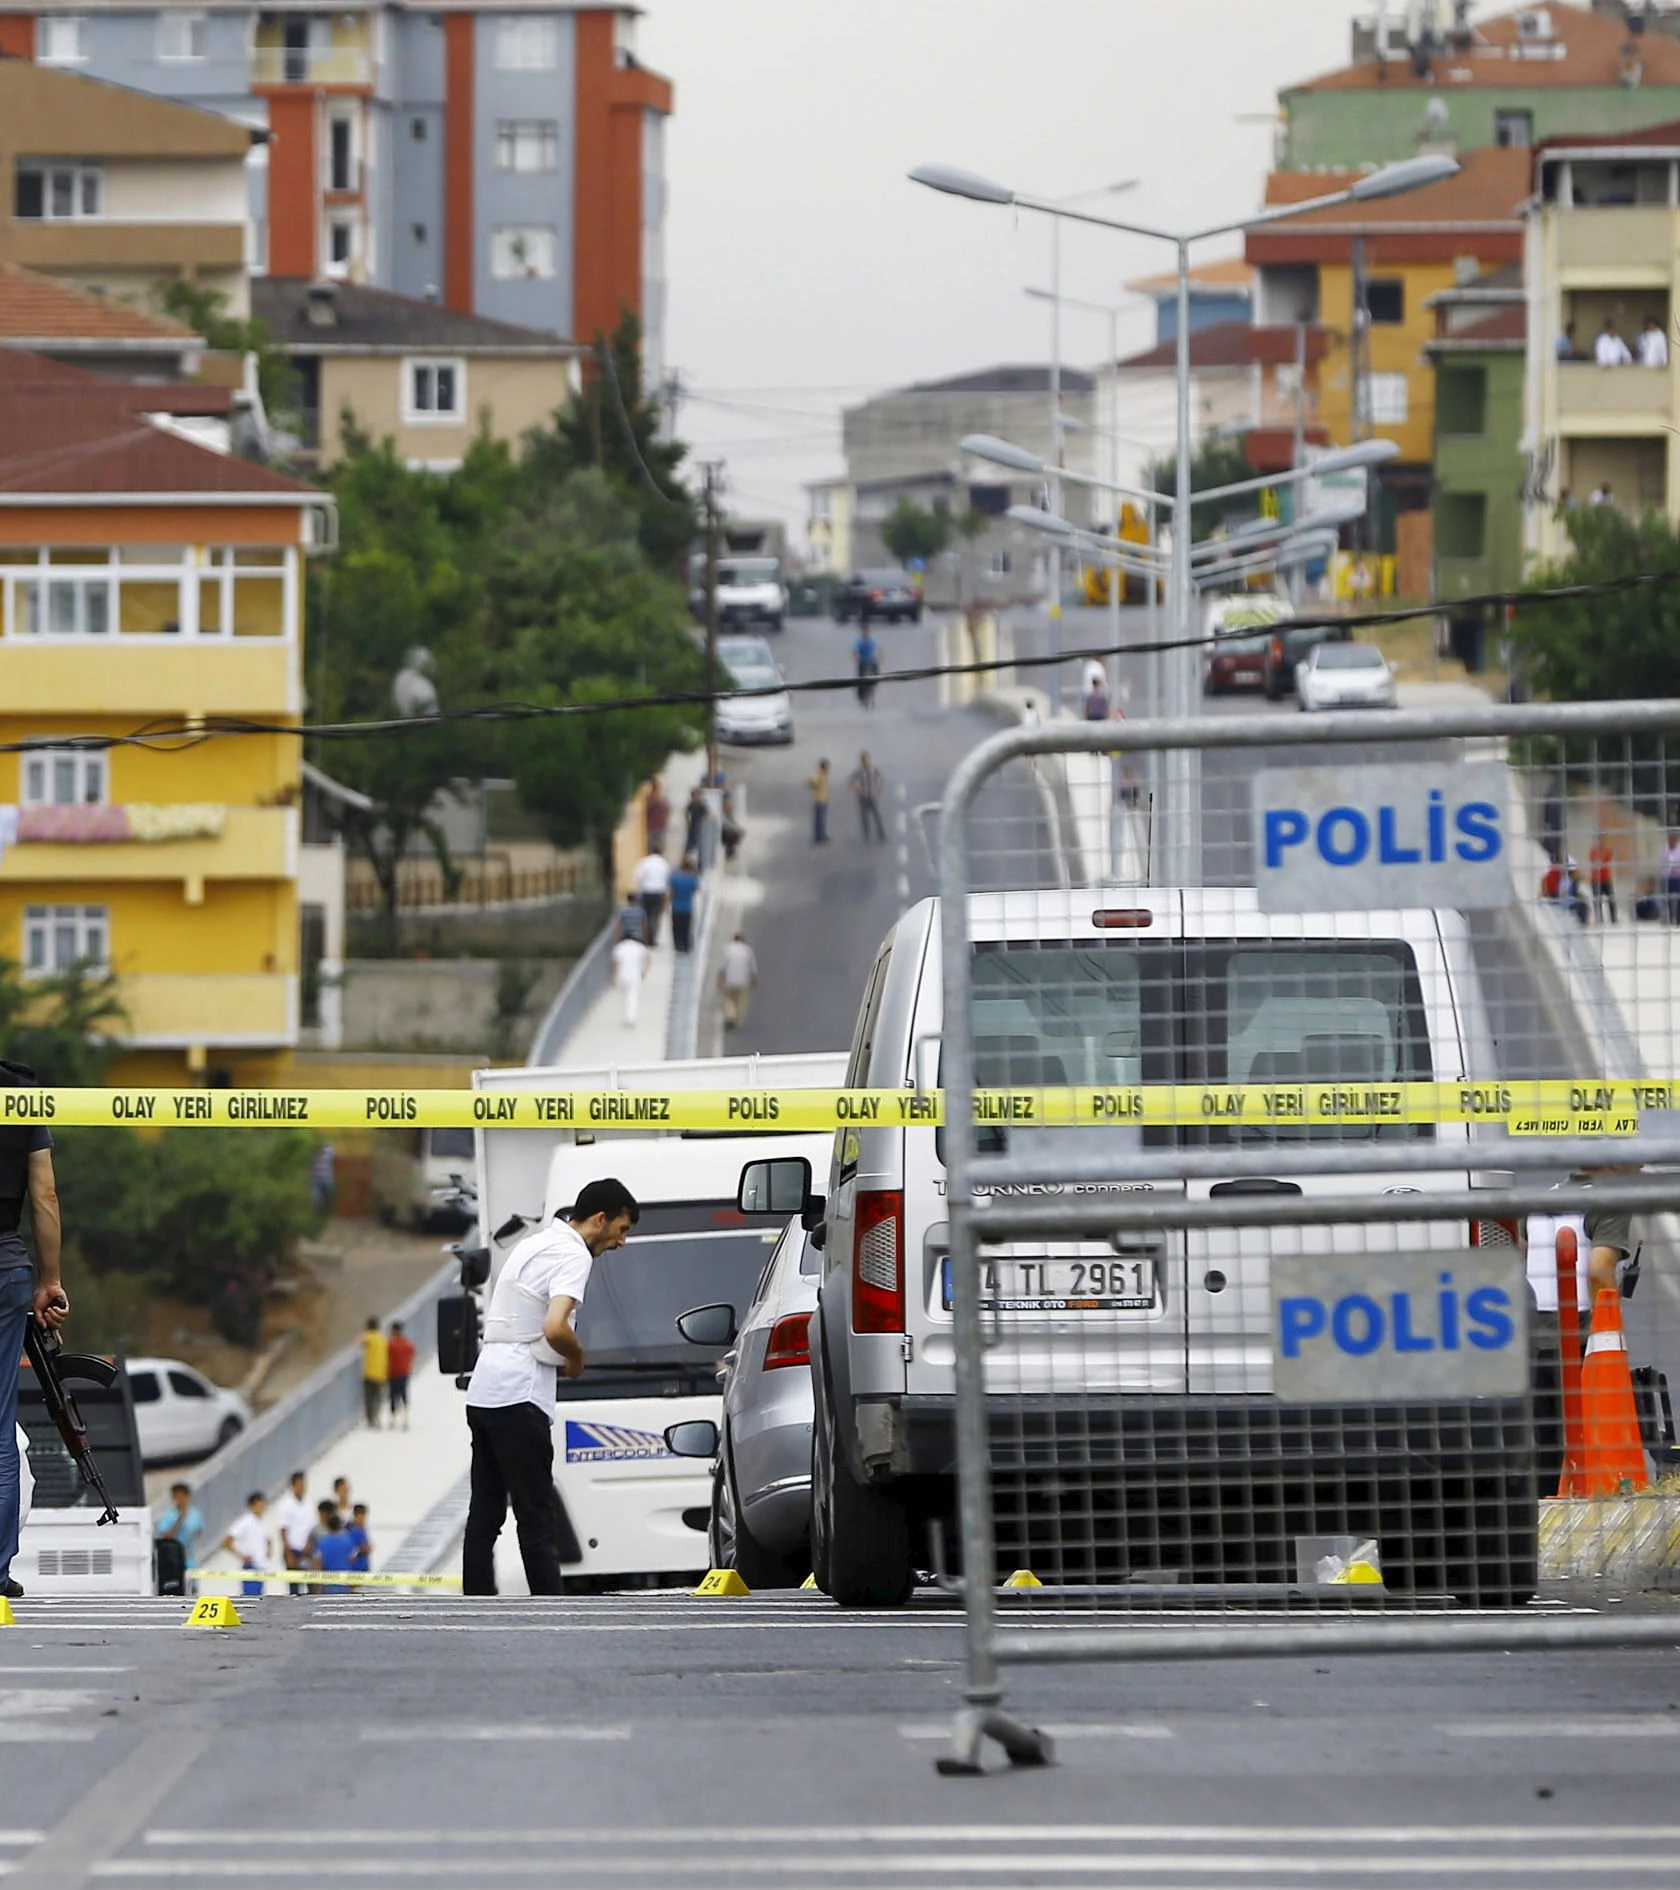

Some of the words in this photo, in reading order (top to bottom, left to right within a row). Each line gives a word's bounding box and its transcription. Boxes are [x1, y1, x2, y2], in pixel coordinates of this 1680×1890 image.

[1264, 789, 1503, 868] POLİS
[5, 1090, 56, 1118] POLİS
[112, 1096, 156, 1119] OLAY
[173, 1092, 212, 1119] YERİ
[227, 1092, 309, 1120] GİRİLMEZ
[366, 1092, 417, 1120] POLİS
[473, 1097, 517, 1120] OLAY
[534, 1092, 574, 1120] YERİ
[589, 1093, 670, 1120] GİRİLMEZ
[728, 1092, 779, 1120] POLİS
[836, 1096, 880, 1120] OLAY
[897, 1091, 937, 1119] YERİ
[971, 1090, 1035, 1119] RİLMEZ
[1093, 1088, 1144, 1118] POLİS
[1201, 1093, 1246, 1117] OLAY
[1263, 1087, 1304, 1116] YERİ
[1319, 1087, 1402, 1116] GİRİLMEZ
[1460, 1083, 1512, 1114] POLİS
[1570, 1088, 1615, 1112] OLAY
[1633, 1083, 1672, 1111] YERİ
[1615, 1119, 1639, 1131] LAY
[933, 1179, 1065, 1197] TURNEO
[1019, 1263, 1055, 1296] TL
[1070, 1262, 1144, 1296] 2961
[1043, 1300, 1066, 1310] OTO
[1279, 1271, 1515, 1358] POLİS
[703, 1576, 722, 1590] 24
[198, 1603, 219, 1618] 25
